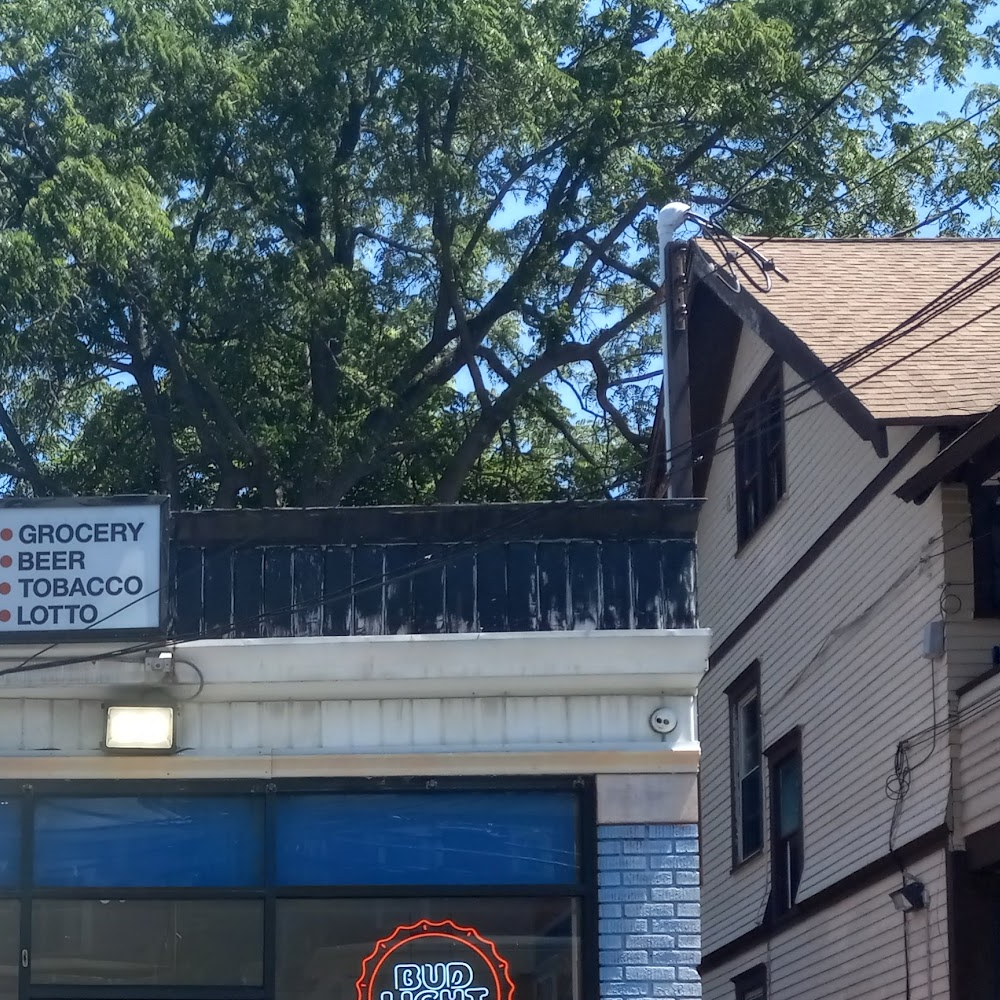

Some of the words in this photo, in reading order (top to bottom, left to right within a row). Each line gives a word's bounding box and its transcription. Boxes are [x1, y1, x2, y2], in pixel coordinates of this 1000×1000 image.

[18, 522, 144, 545] GROCERY
[17, 551, 85, 571] BEER
[18, 576, 143, 598] TOBACCO
[17, 604, 98, 626] LOTTO
[394, 962, 474, 991] BUD
